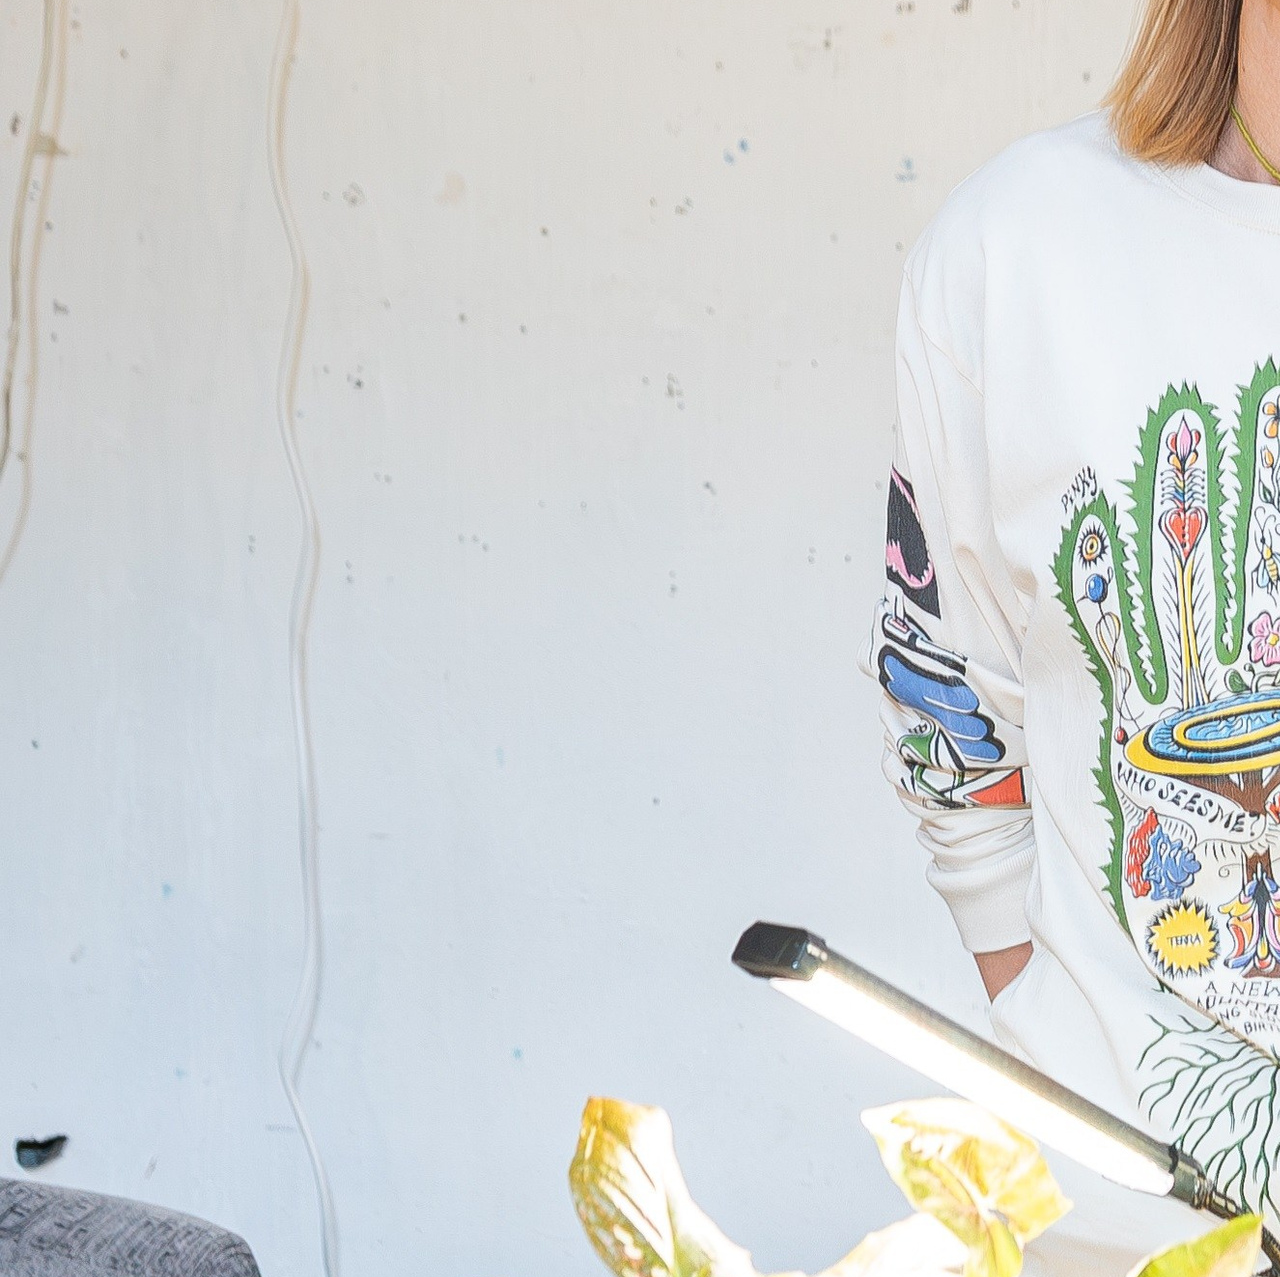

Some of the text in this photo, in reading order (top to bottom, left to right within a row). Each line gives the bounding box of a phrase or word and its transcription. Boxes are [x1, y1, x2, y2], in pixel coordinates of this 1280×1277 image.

[1117, 761, 1157, 796] WHO
[1158, 781, 1213, 817] SEES
[1167, 932, 1202, 947] TERRA
[1205, 980, 1218, 995] A
